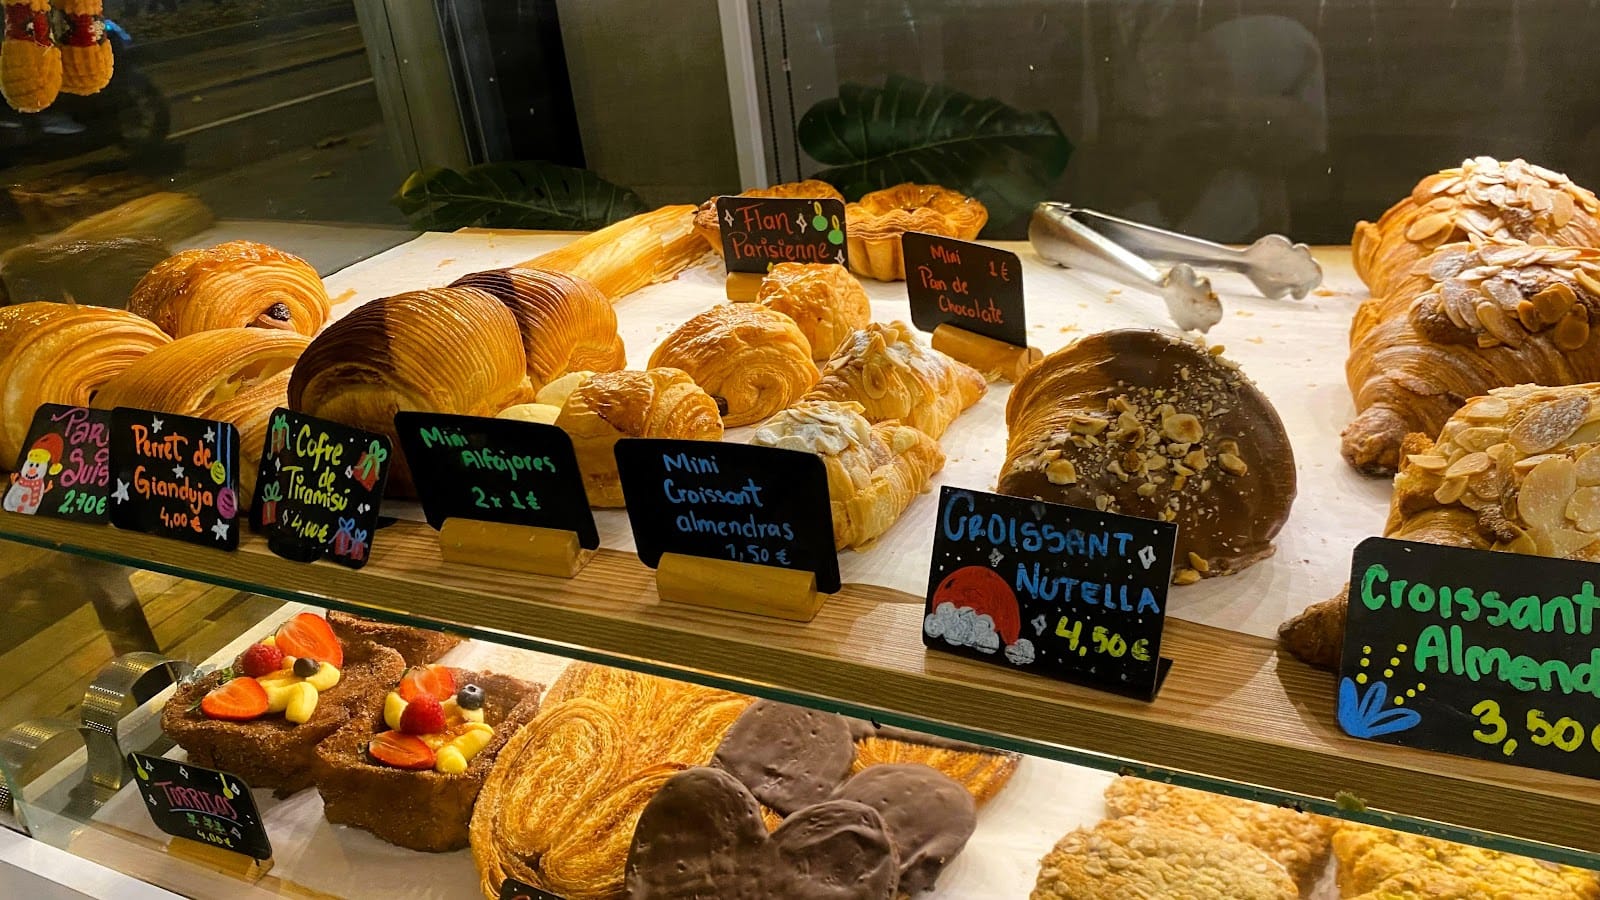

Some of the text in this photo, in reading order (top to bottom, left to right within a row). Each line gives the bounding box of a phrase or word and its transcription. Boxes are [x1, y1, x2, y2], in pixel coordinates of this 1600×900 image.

[736, 202, 794, 235] Flan
[728, 231, 830, 262] Parisienne
[930, 244, 961, 264] Mini
[918, 265, 969, 295] Pan de
[939, 294, 1004, 324] Chocolate
[131, 424, 212, 469] Perret de
[296, 424, 343, 471] Cofre
[420, 426, 469, 448] Mini
[318, 466, 336, 492] de
[461, 447, 556, 480] Alfajores
[663, 453, 719, 474] Mini
[134, 465, 213, 515] Gianduja
[664, 478, 763, 507] Croissant
[676, 509, 794, 541] almendras
[943, 491, 1134, 560] CROISSANT
[1015, 562, 1160, 614] NUTELLA
[1361, 563, 1600, 635] Croissant
